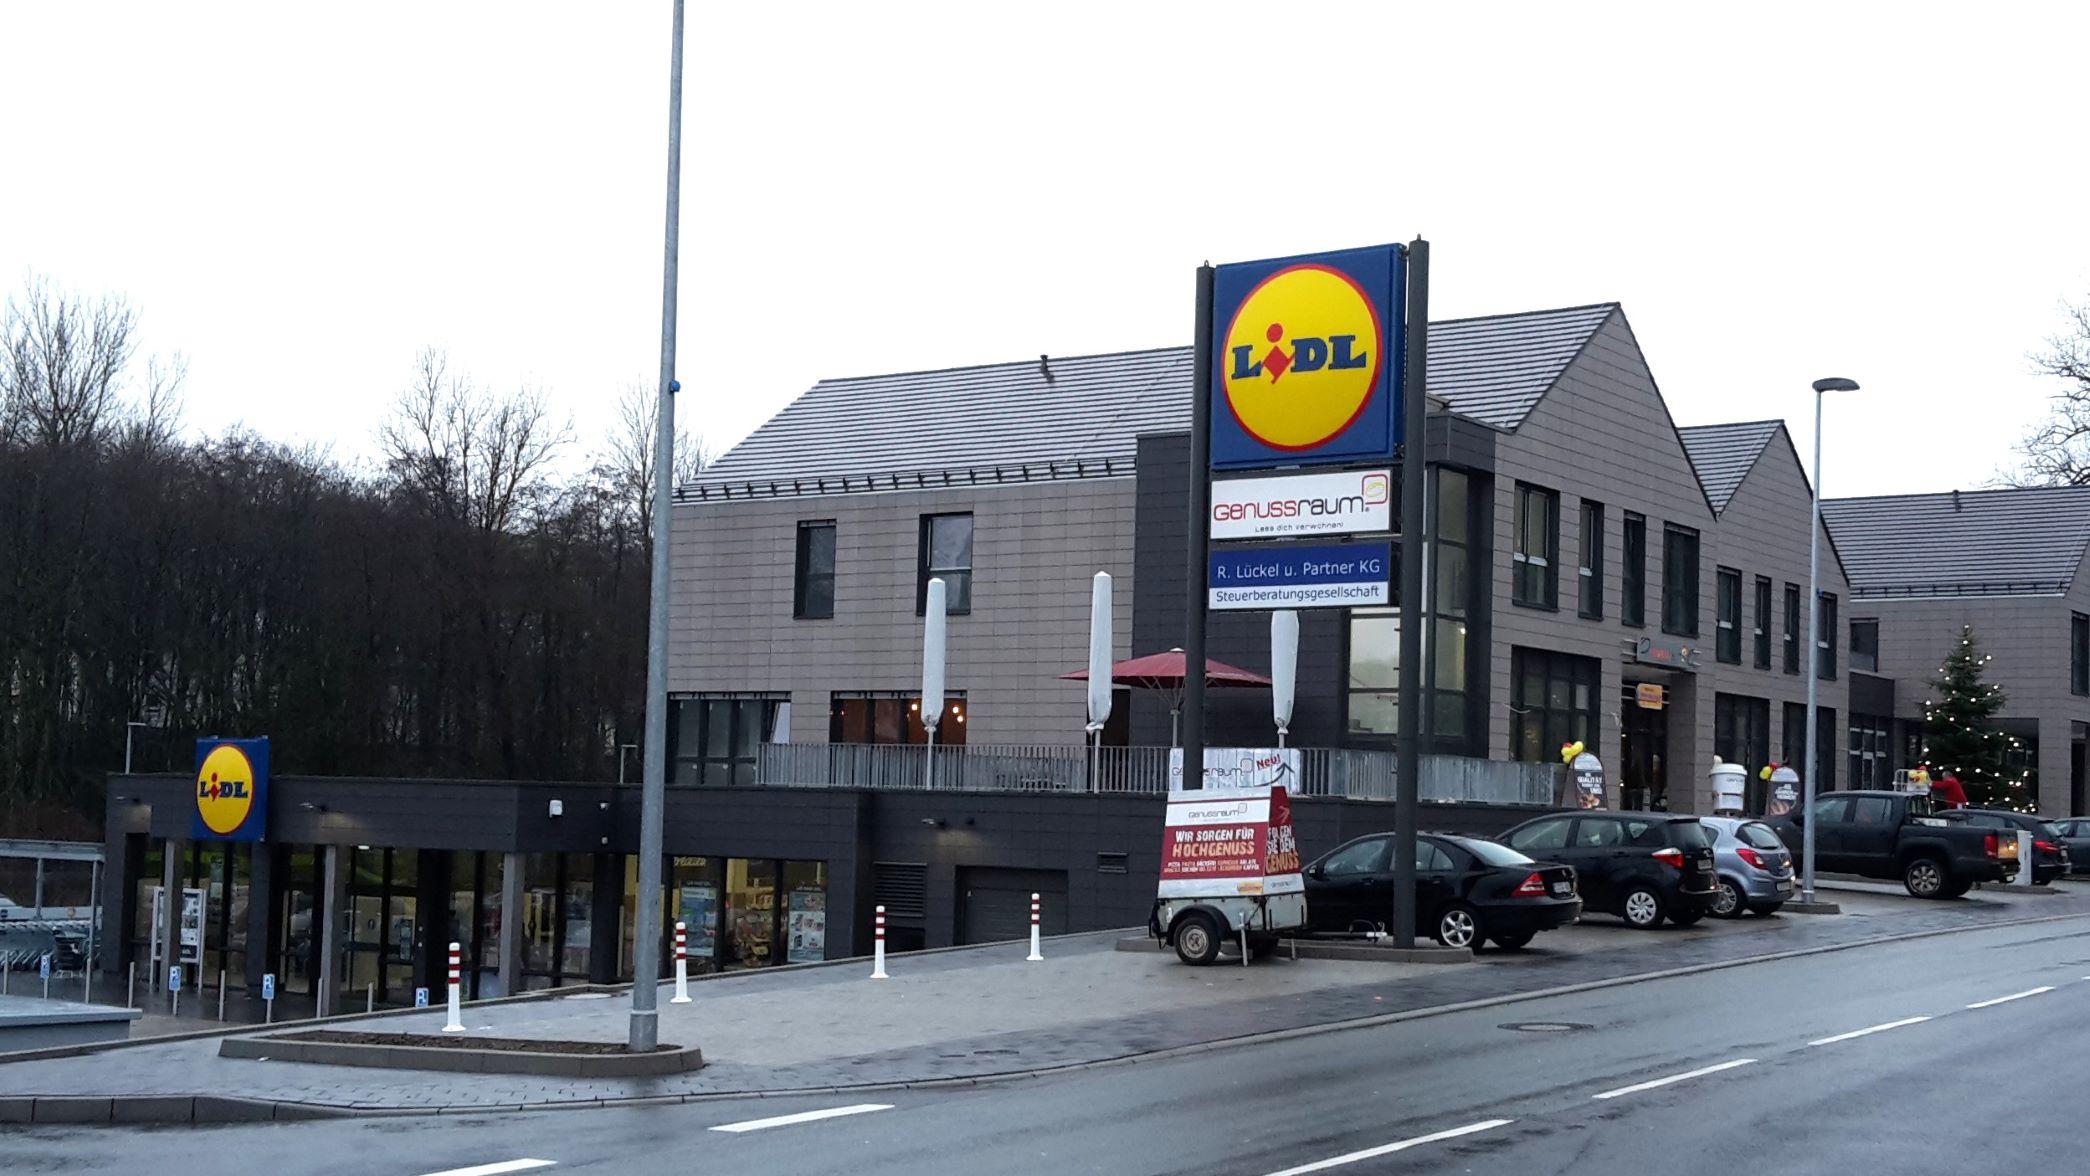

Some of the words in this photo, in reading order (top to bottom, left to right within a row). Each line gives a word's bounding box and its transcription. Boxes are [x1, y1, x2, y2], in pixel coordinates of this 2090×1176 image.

[1217, 565, 1230, 579] R.
[1236, 563, 1279, 578] Lückel
[1284, 566, 1297, 576] u.
[1303, 561, 1354, 576] Partner
[1359, 559, 1380, 573] KG
[1216, 585, 1379, 602] Steuerberatungsgesellschaft
[1256, 754, 1282, 770] Neu!
[1175, 830, 1194, 843] WIR
[1196, 829, 1233, 842] SORGEN
[1235, 826, 1255, 840] FÜR
[1267, 824, 1292, 840] FOLGEN
[1172, 841, 1255, 857] HOCHGENUSS
[1266, 840, 1279, 855] SIE
[1279, 837, 1296, 853] DEM
[1265, 852, 1299, 874] GENUSS
